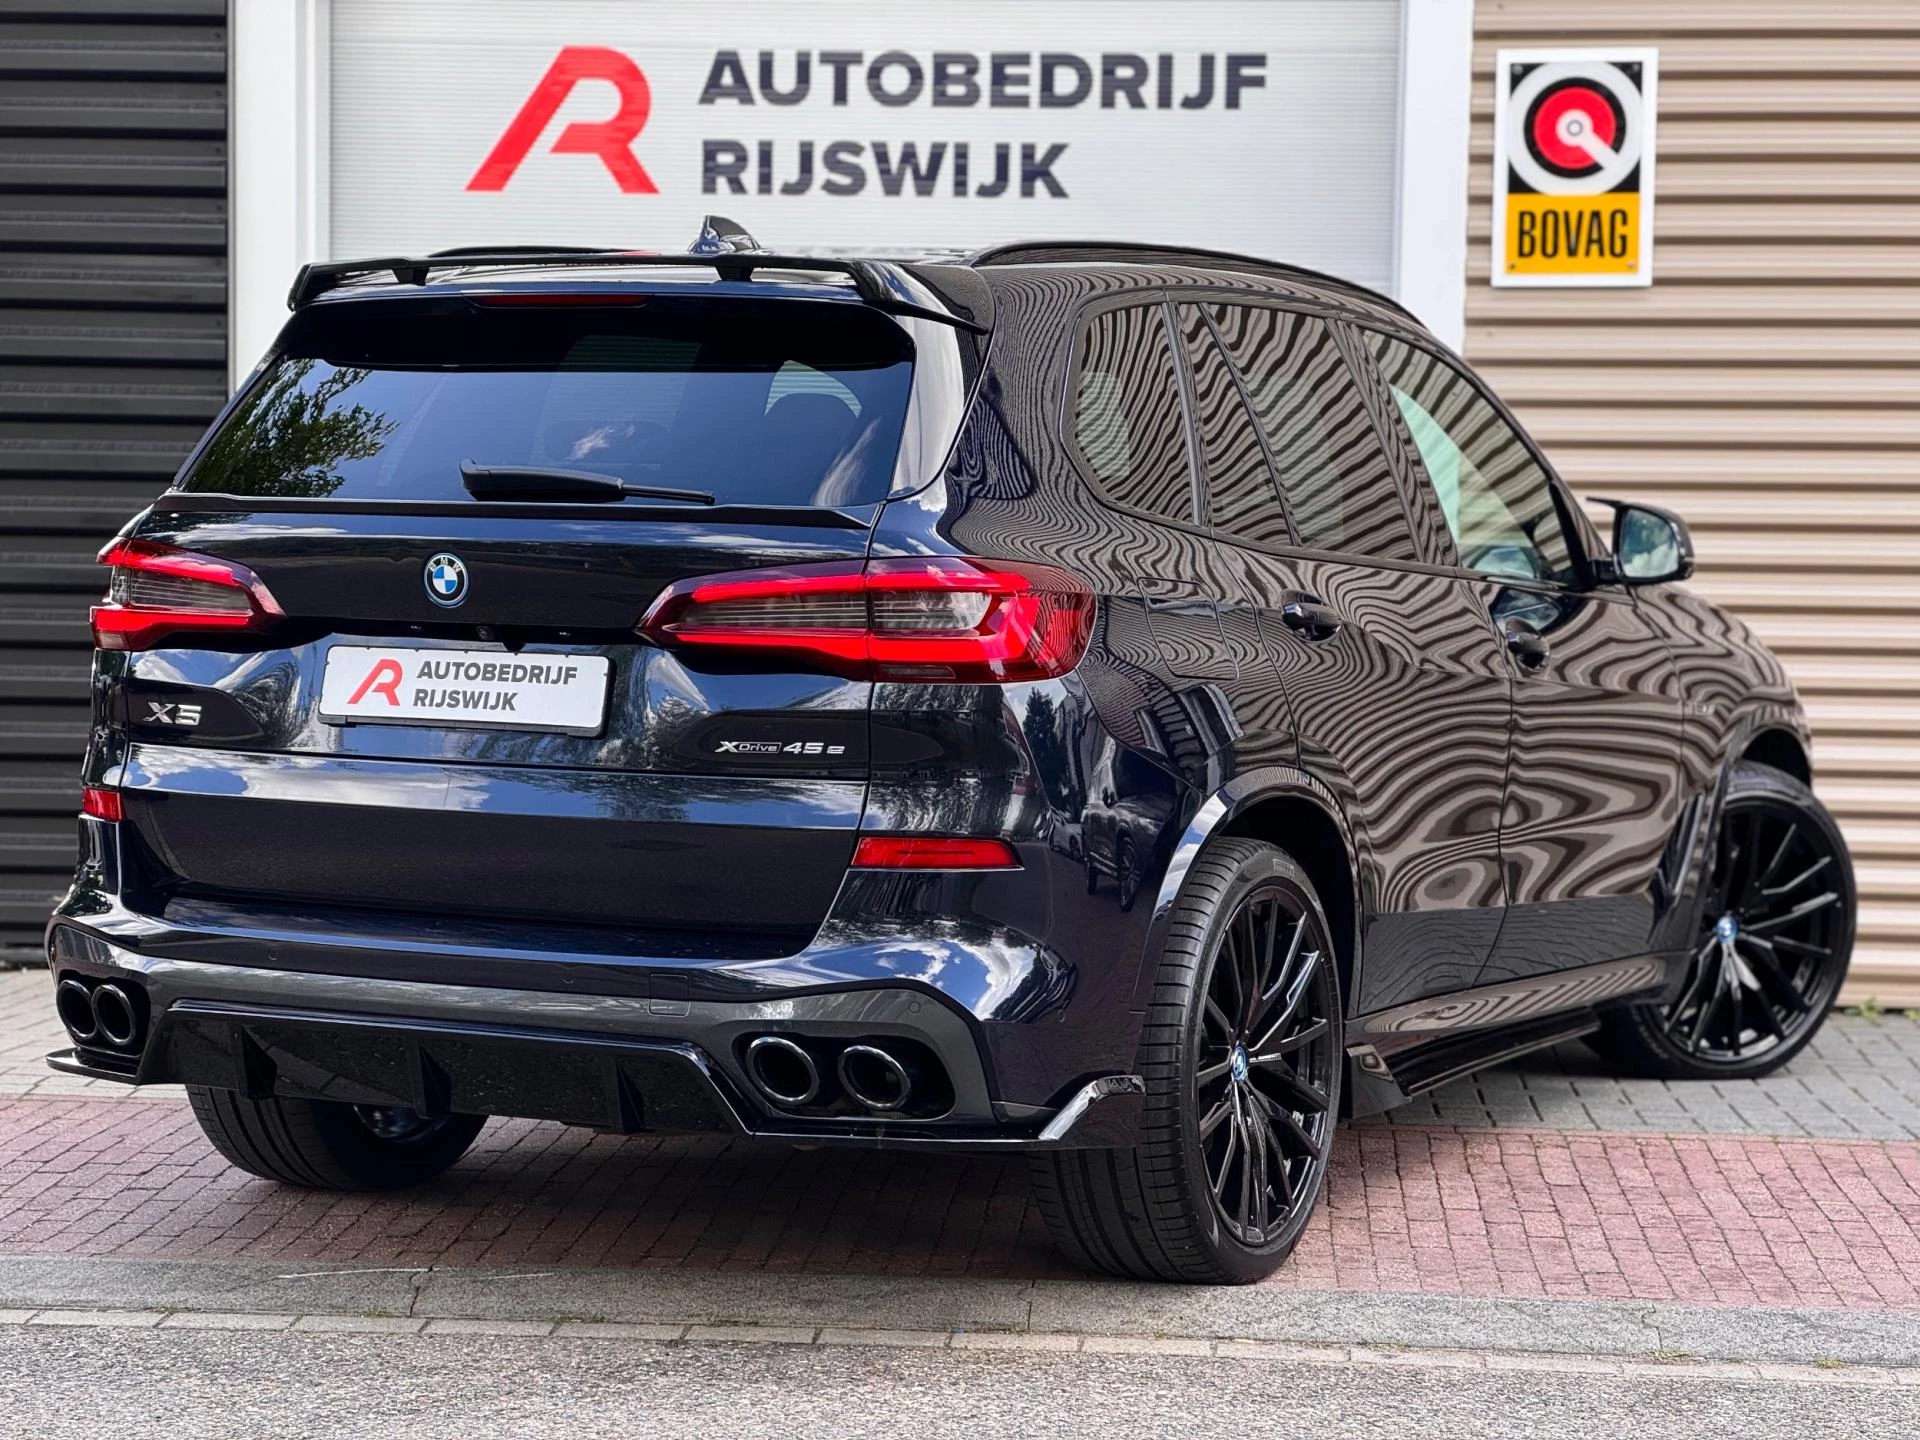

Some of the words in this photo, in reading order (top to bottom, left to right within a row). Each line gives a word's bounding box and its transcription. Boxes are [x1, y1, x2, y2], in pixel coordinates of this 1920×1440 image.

[699, 50, 1268, 111] AUTOBEDRIJF
[701, 140, 1070, 199] RIJSWIJK
[1517, 209, 1628, 258] BOVAG
[417, 661, 577, 685] AUTOBEDRIJF
[142, 702, 202, 725] X5
[413, 689, 518, 711] RIJSWIJK
